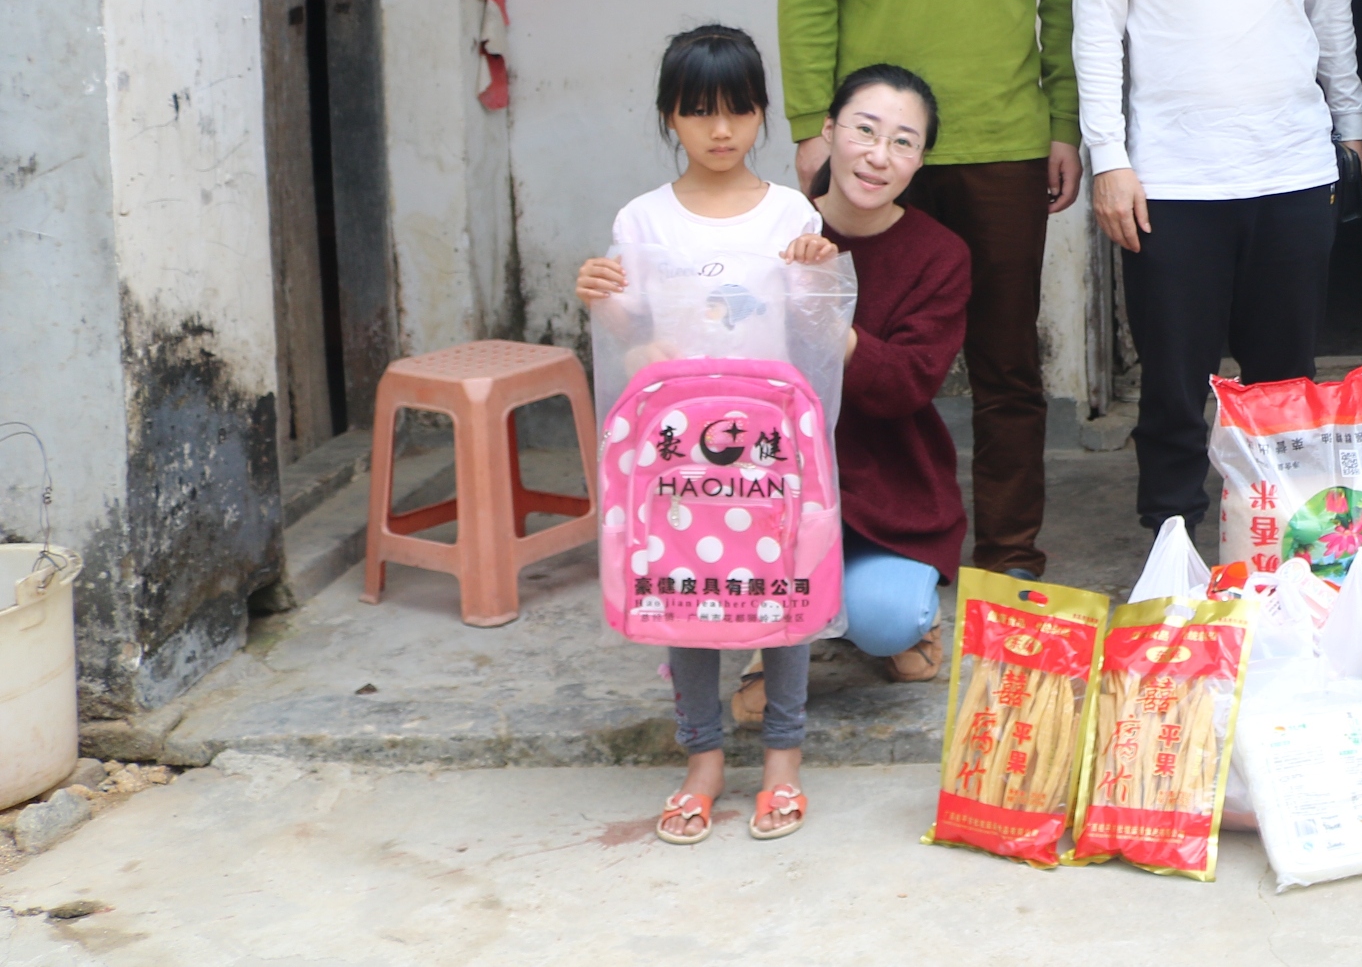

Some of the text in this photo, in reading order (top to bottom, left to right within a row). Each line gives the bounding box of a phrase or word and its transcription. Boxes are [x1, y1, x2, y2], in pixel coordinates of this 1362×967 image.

[659, 476, 785, 498] HAOJIAN
[634, 577, 811, 596] 豪健皮具有限公司
[957, 707, 997, 796] 腐竹
[1097, 714, 1141, 805] 腐竹
